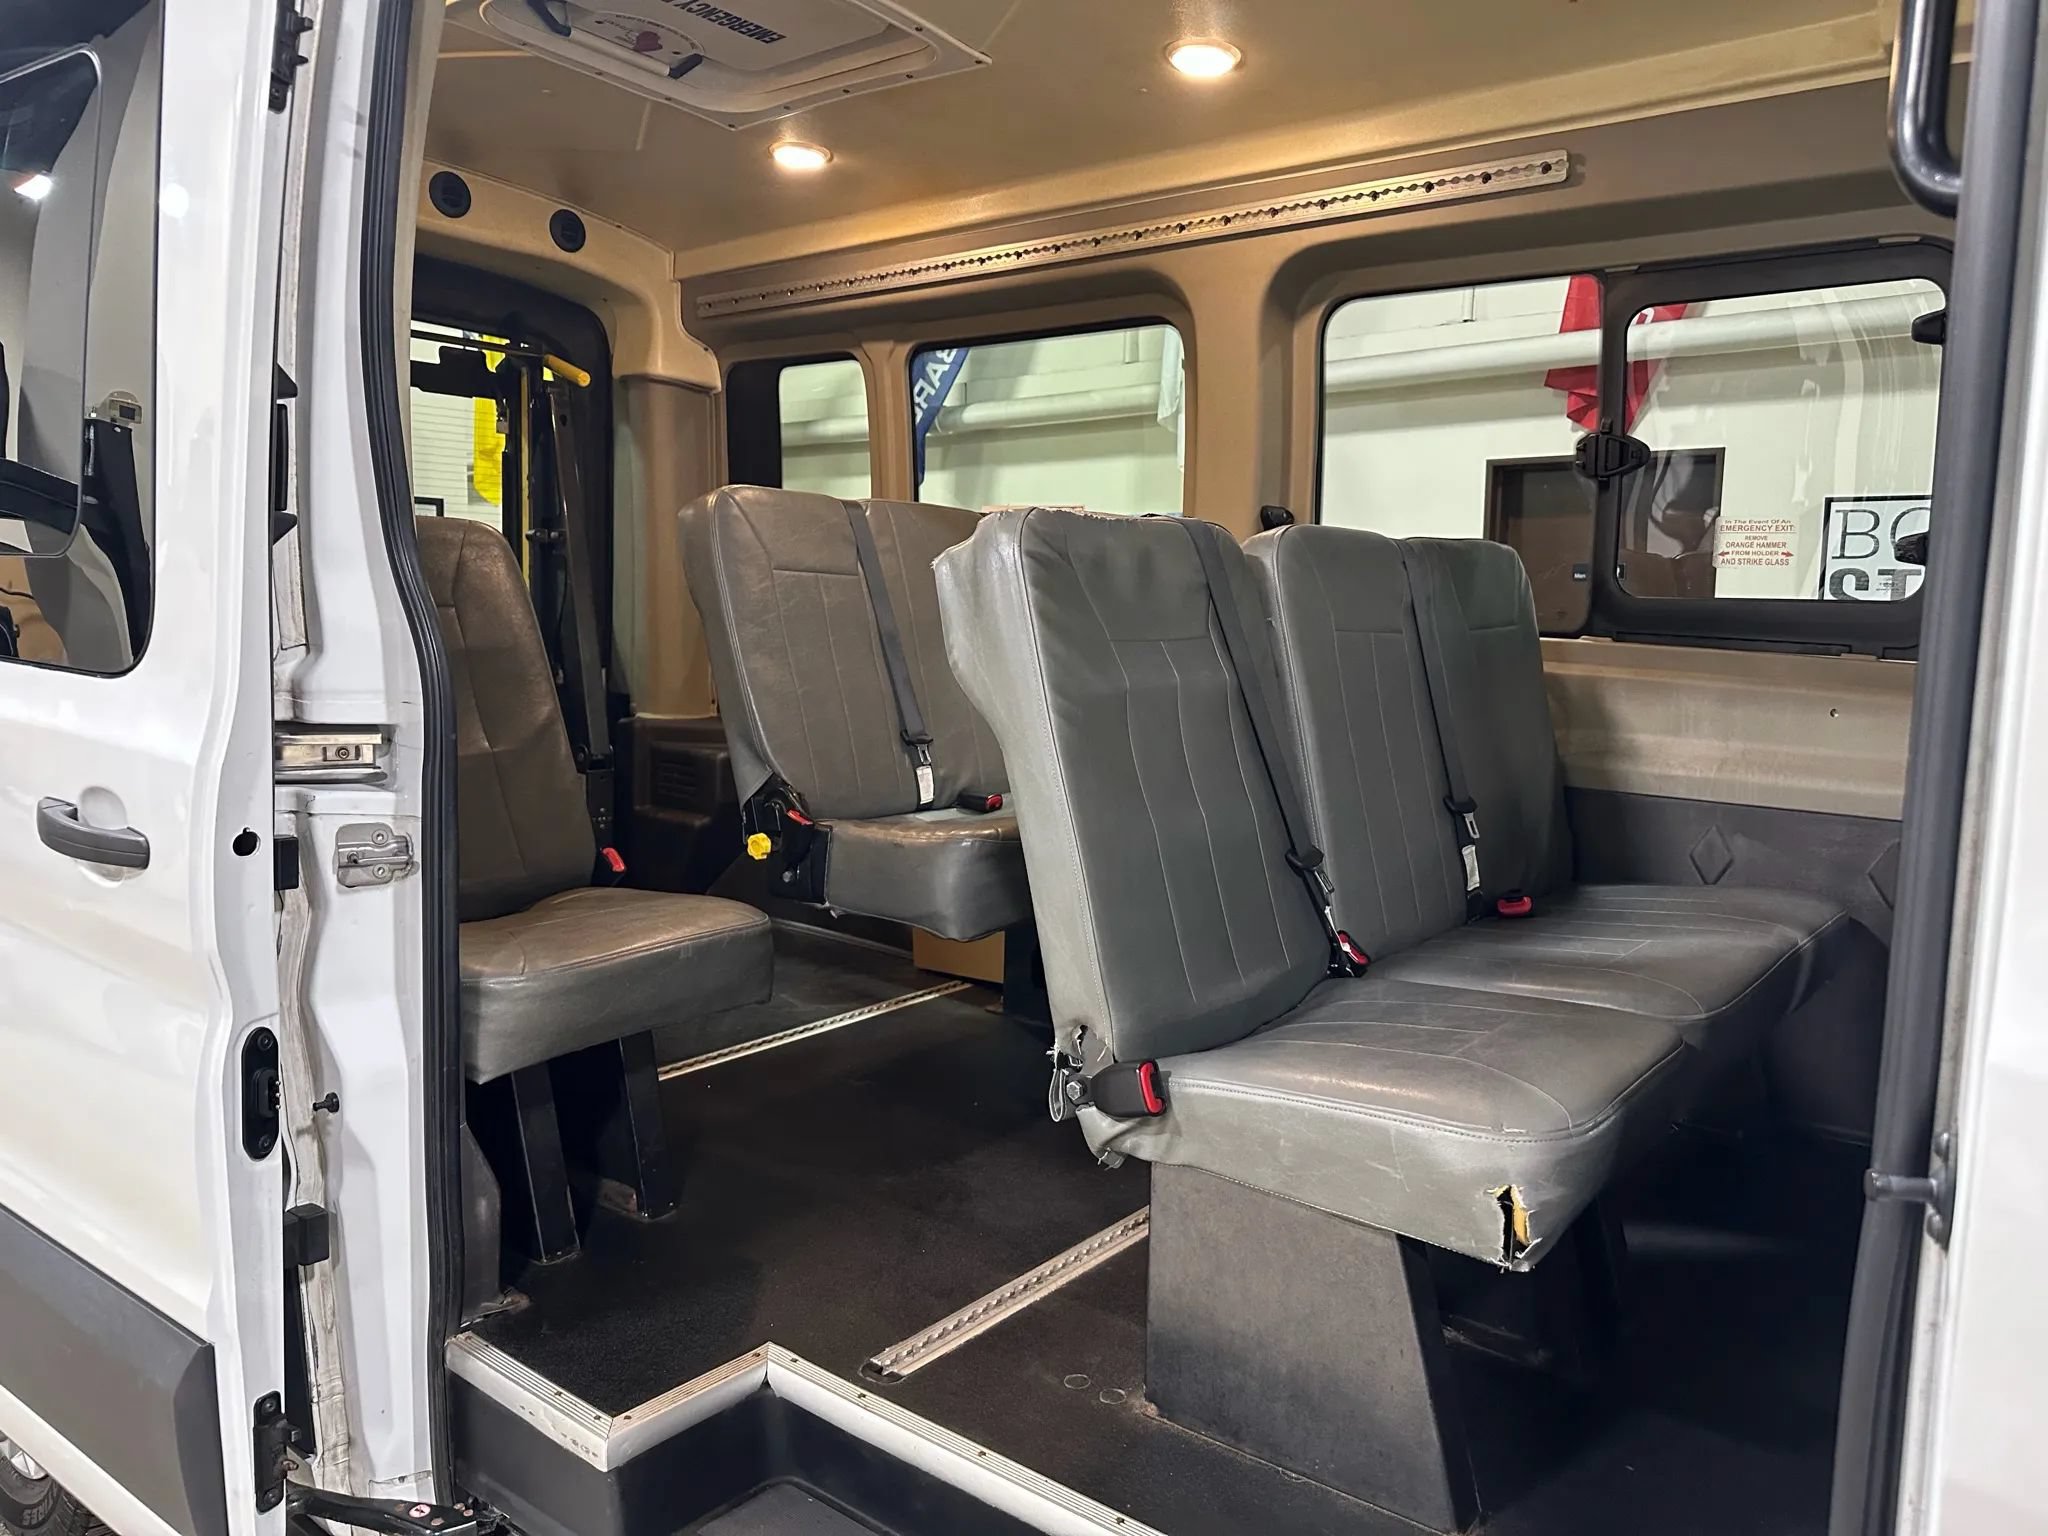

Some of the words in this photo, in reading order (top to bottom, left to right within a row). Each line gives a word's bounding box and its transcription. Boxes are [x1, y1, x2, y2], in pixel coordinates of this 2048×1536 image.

[673, 0, 787, 44] EMERGENCY
[1720, 524, 1773, 532] EMERGENCY
[1725, 541, 1755, 549] ORANGE
[1756, 541, 1787, 549] HAMMER
[1720, 558, 1736, 566] AND
[1736, 558, 1763, 566] STRIKE
[1764, 558, 1790, 566] GLASS
